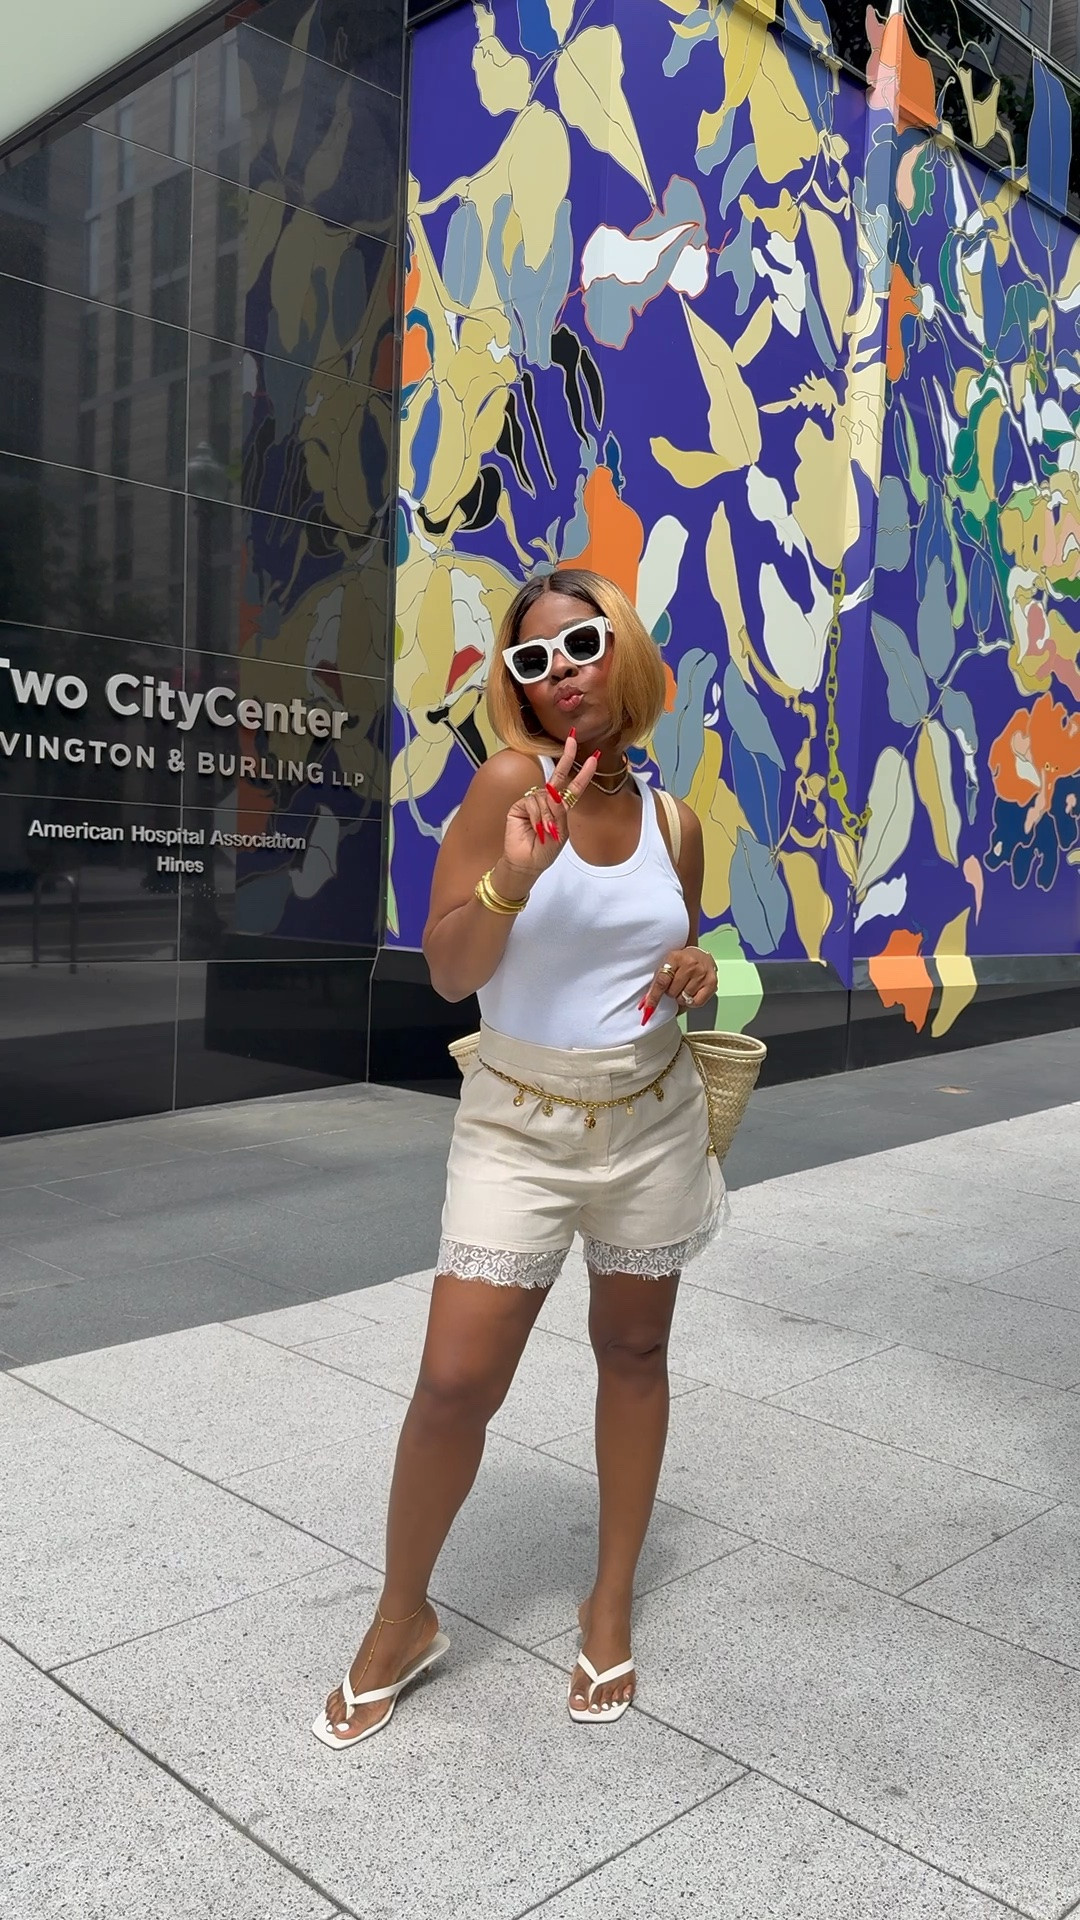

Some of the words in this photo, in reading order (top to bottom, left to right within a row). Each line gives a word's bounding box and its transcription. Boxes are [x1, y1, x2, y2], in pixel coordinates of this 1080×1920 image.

[105, 672, 350, 740] CityCenter
[168, 748, 186, 773] &
[198, 751, 324, 784] BURLING
[331, 770, 365, 788] LLP
[28, 819, 124, 842] American
[131, 825, 205, 846] Hospital
[210, 829, 307, 851] Association
[156, 856, 205, 874] Hines
